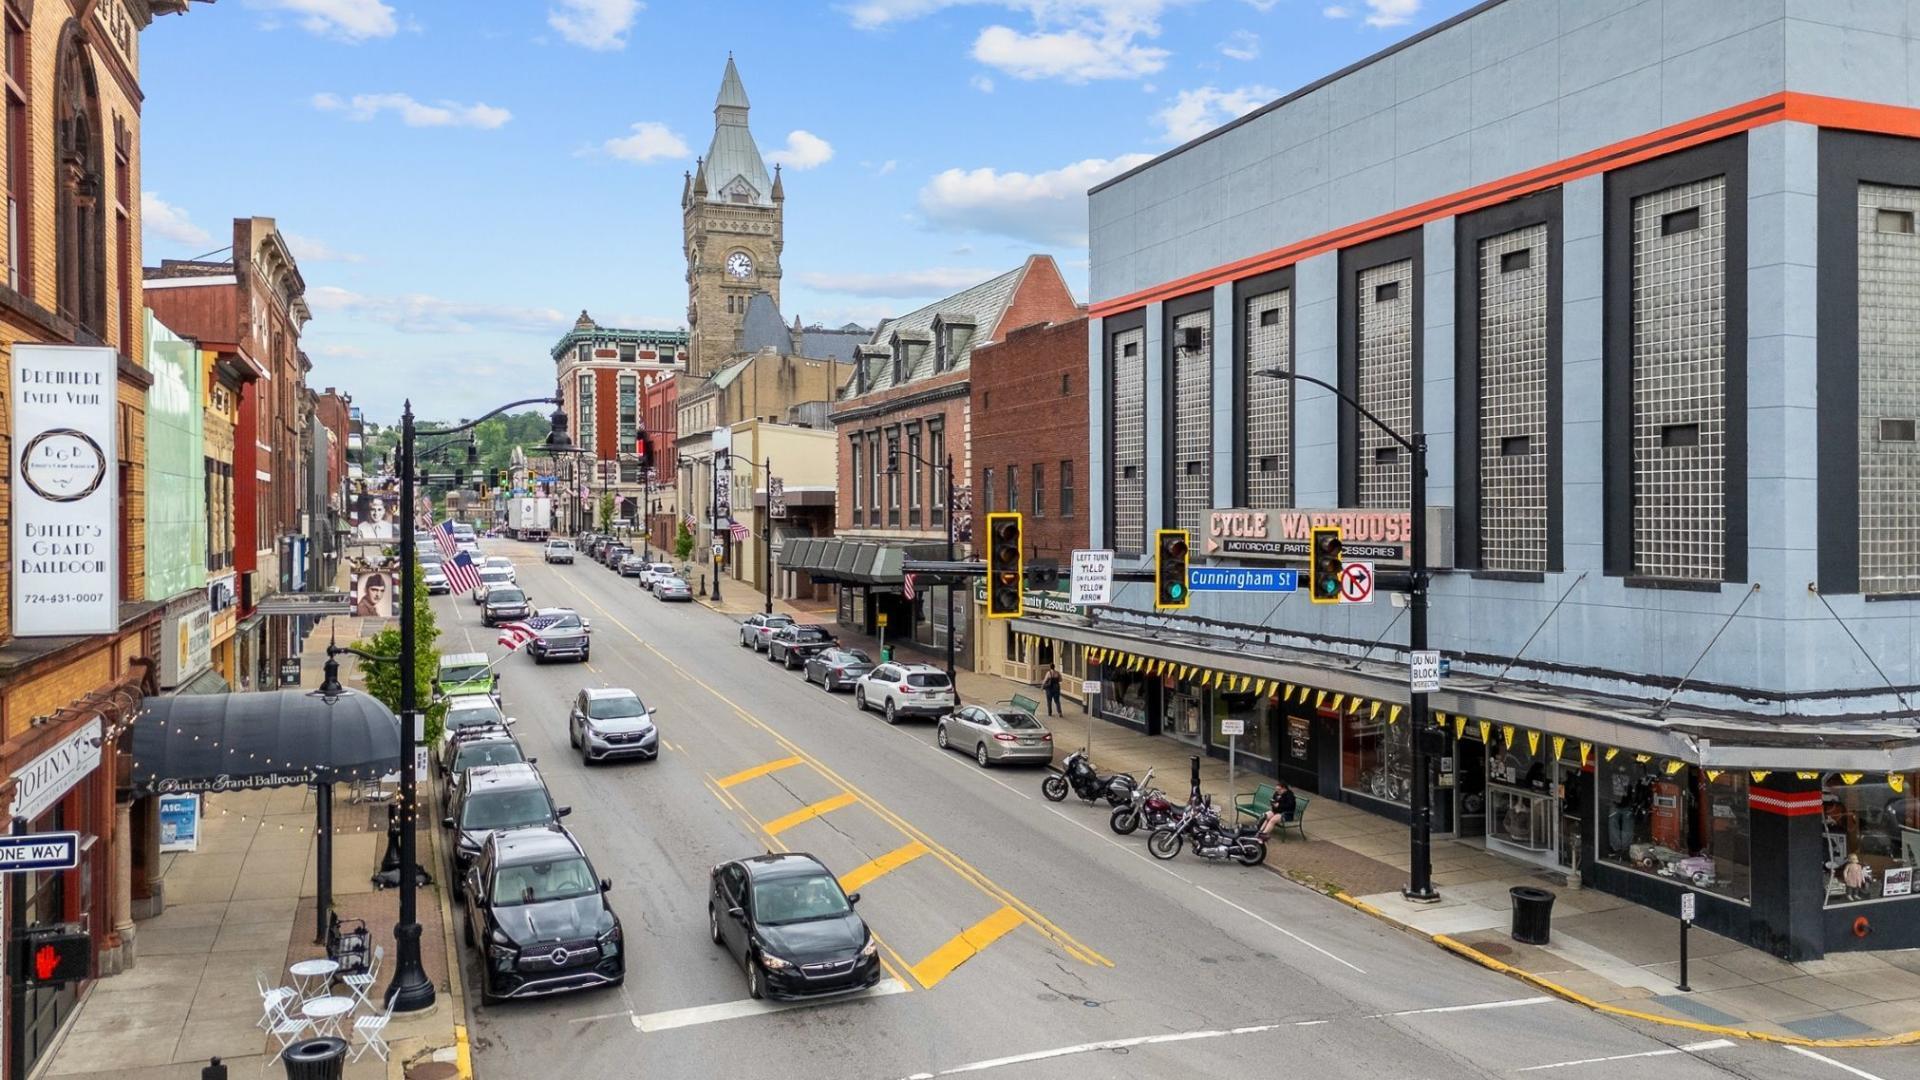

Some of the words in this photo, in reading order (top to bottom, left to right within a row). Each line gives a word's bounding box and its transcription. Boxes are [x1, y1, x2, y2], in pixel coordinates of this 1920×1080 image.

[1210, 512, 1268, 538] CYCLE
[1228, 541, 1281, 552] MOTORCYCLE
[1283, 544, 1311, 553] PARTS
[1341, 545, 1395, 557] CESSORIES
[1093, 553, 1109, 561] TURN
[1081, 563, 1105, 573] YIELD
[1191, 570, 1273, 589] Cunningham
[1279, 572, 1291, 586] St
[1079, 583, 1103, 592] YELLOW
[1080, 593, 1102, 601] ARROW
[1044, 598, 1077, 613] Resources
[1413, 655, 1423, 666] DO
[1424, 655, 1437, 665] NOT
[1413, 668, 1438, 679] BLOCK
[158, 778, 211, 793] Butler's
[212, 773, 253, 791] Grand
[254, 773, 309, 786] Ballroom
[32, 845, 64, 859] WAY
